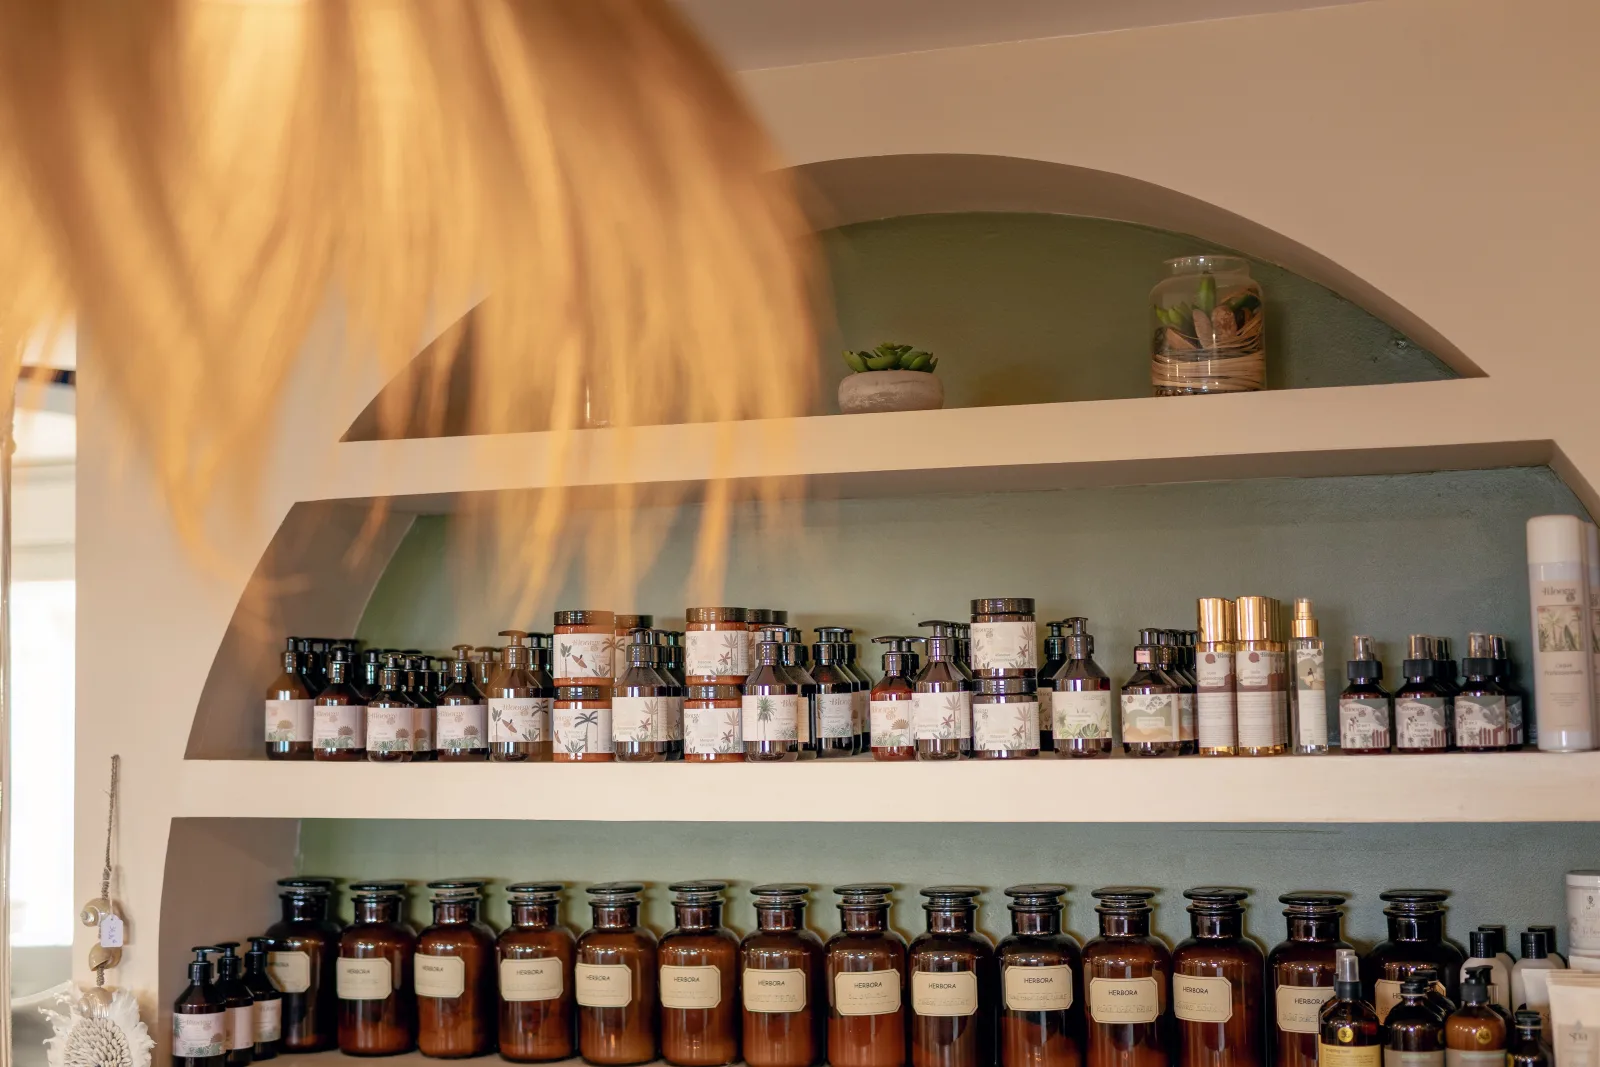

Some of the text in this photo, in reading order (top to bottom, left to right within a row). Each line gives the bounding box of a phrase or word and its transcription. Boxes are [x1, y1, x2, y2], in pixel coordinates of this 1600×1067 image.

[854, 981, 883, 989] HERBORA
[928, 982, 957, 990] HERBORA
[1182, 986, 1209, 994] HERBORA
